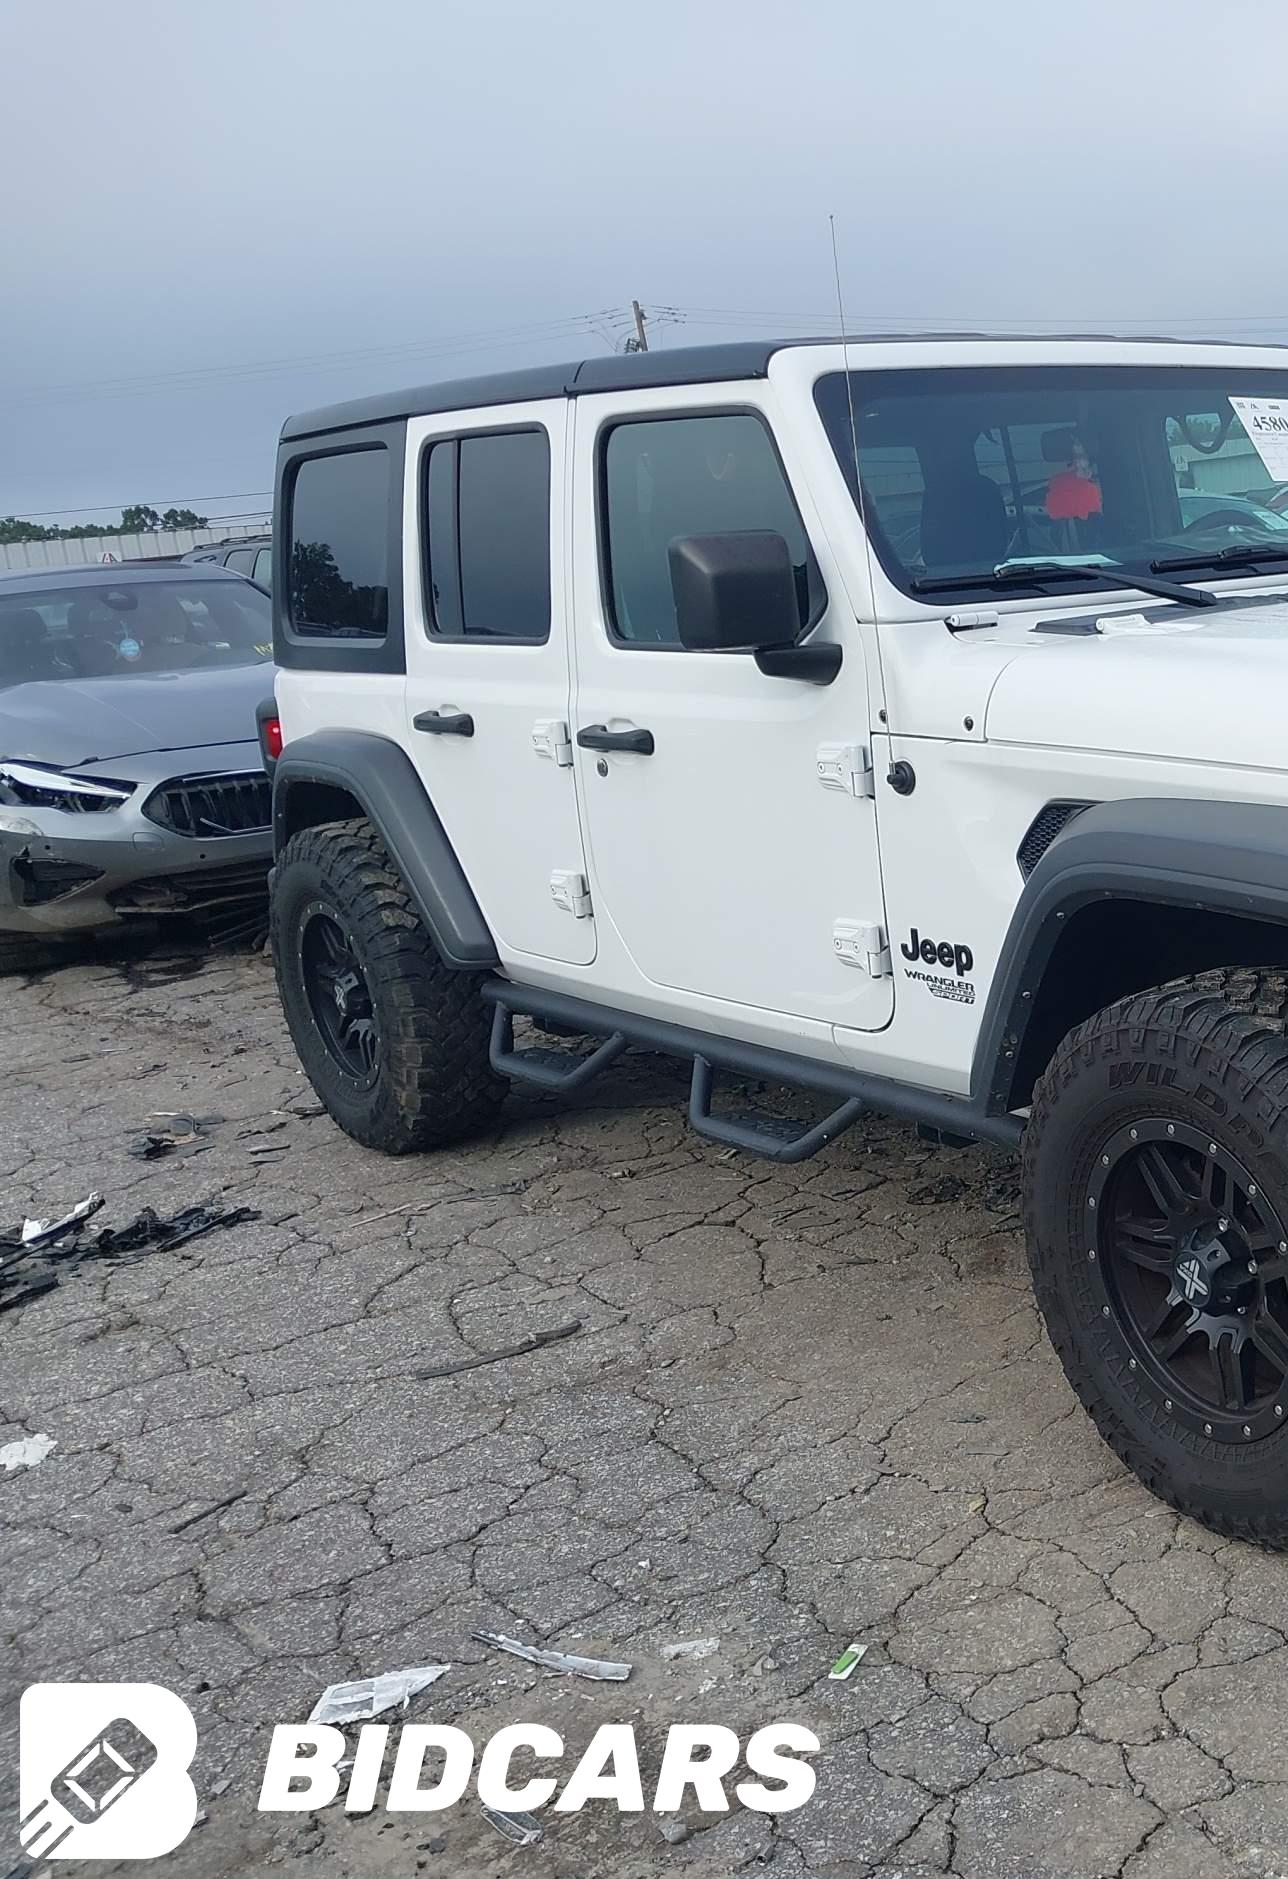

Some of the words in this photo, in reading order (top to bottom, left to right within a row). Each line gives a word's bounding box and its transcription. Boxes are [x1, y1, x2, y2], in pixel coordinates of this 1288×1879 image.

[900, 928, 973, 976] Jeep
[903, 968, 975, 992] WRANGLER
[926, 982, 976, 997] UNLIMITED
[931, 989, 975, 1004] SPORT
